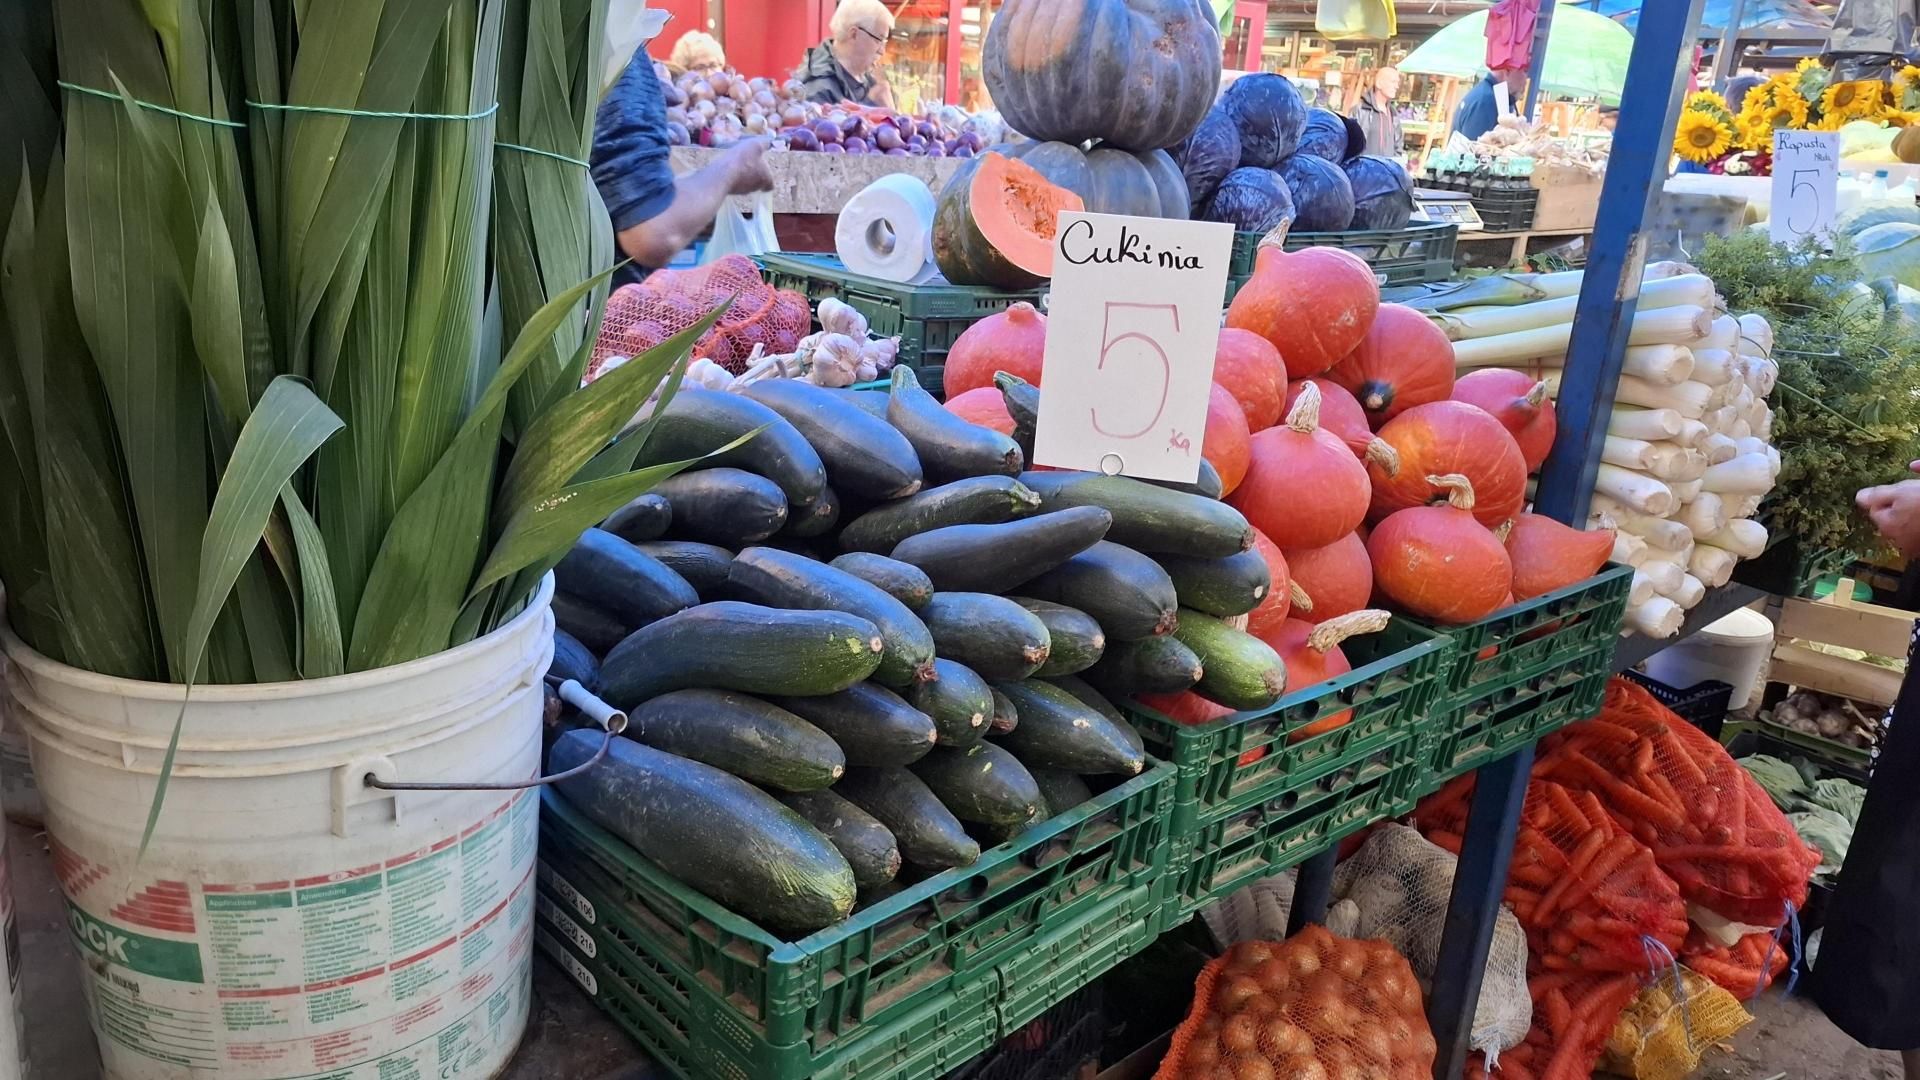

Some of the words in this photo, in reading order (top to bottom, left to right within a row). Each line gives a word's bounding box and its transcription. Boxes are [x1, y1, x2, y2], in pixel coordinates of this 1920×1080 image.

[1778, 132, 1827, 155] Kapusta
[1788, 168, 1820, 235] 5
[1060, 220, 1204, 270] Cukinia
[1091, 301, 1180, 439] 5
